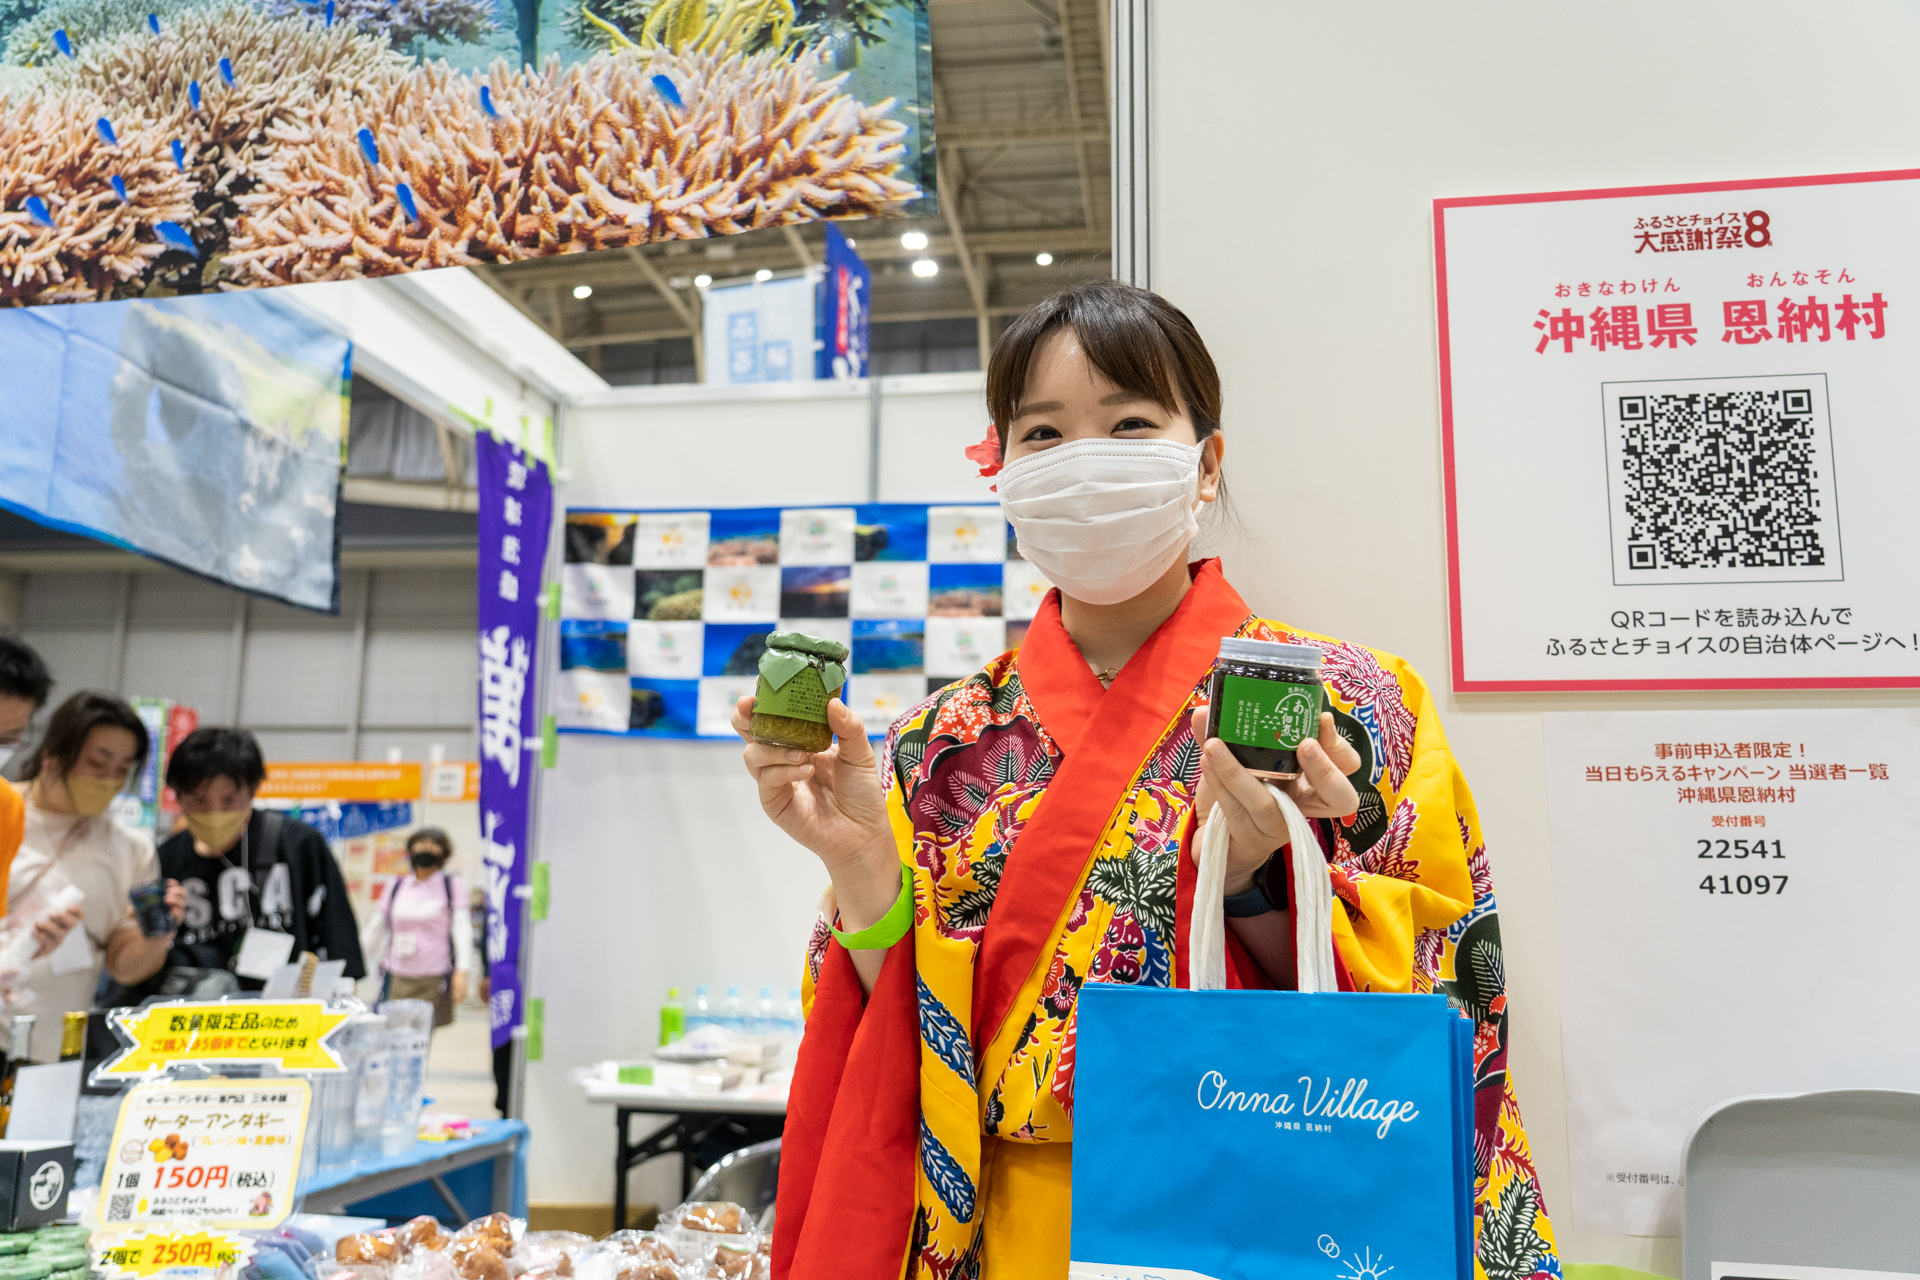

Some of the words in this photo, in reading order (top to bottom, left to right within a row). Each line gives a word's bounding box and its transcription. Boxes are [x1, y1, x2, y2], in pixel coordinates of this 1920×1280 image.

[1634, 211, 1741, 230] ふるさとチョイス
[1634, 225, 1743, 254] 大感謝祭
[1555, 278, 1681, 298] おきなわけん
[1747, 267, 1856, 288] おんなそん
[1533, 303, 1698, 355] 沖縄県
[1721, 292, 1889, 345] 恩納村
[1611, 607, 1853, 629] QRコードを読み込んで
[1546, 633, 1919, 656] ふるさとチョイスの自治体ページへ！
[1281, 712, 1294, 737] 佃煮
[1290, 699, 1305, 742] あーさ
[1654, 742, 1805, 760] 事前申込者限定！
[1585, 765, 1781, 782] 当日もらえるキャンペーン
[1788, 763, 1890, 780] 当選者一覧
[1677, 786, 1796, 803] 沖縄県恩納村
[1711, 815, 1767, 828] 受付番号
[1697, 840, 1786, 859] 22541
[1699, 875, 1789, 894] 41097
[169, 1013, 299, 1032] 数量限定品のため
[1198, 1070, 1295, 1116] Onna
[1297, 1076, 1419, 1139] Village
[144, 1112, 285, 1131] サーターアンダギー
[1275, 1121, 1301, 1131] 沖縄県
[1306, 1123, 1332, 1133] 恩納村
[117, 1172, 140, 1188] 1個
[99, 1249, 142, 1266] 2個で
